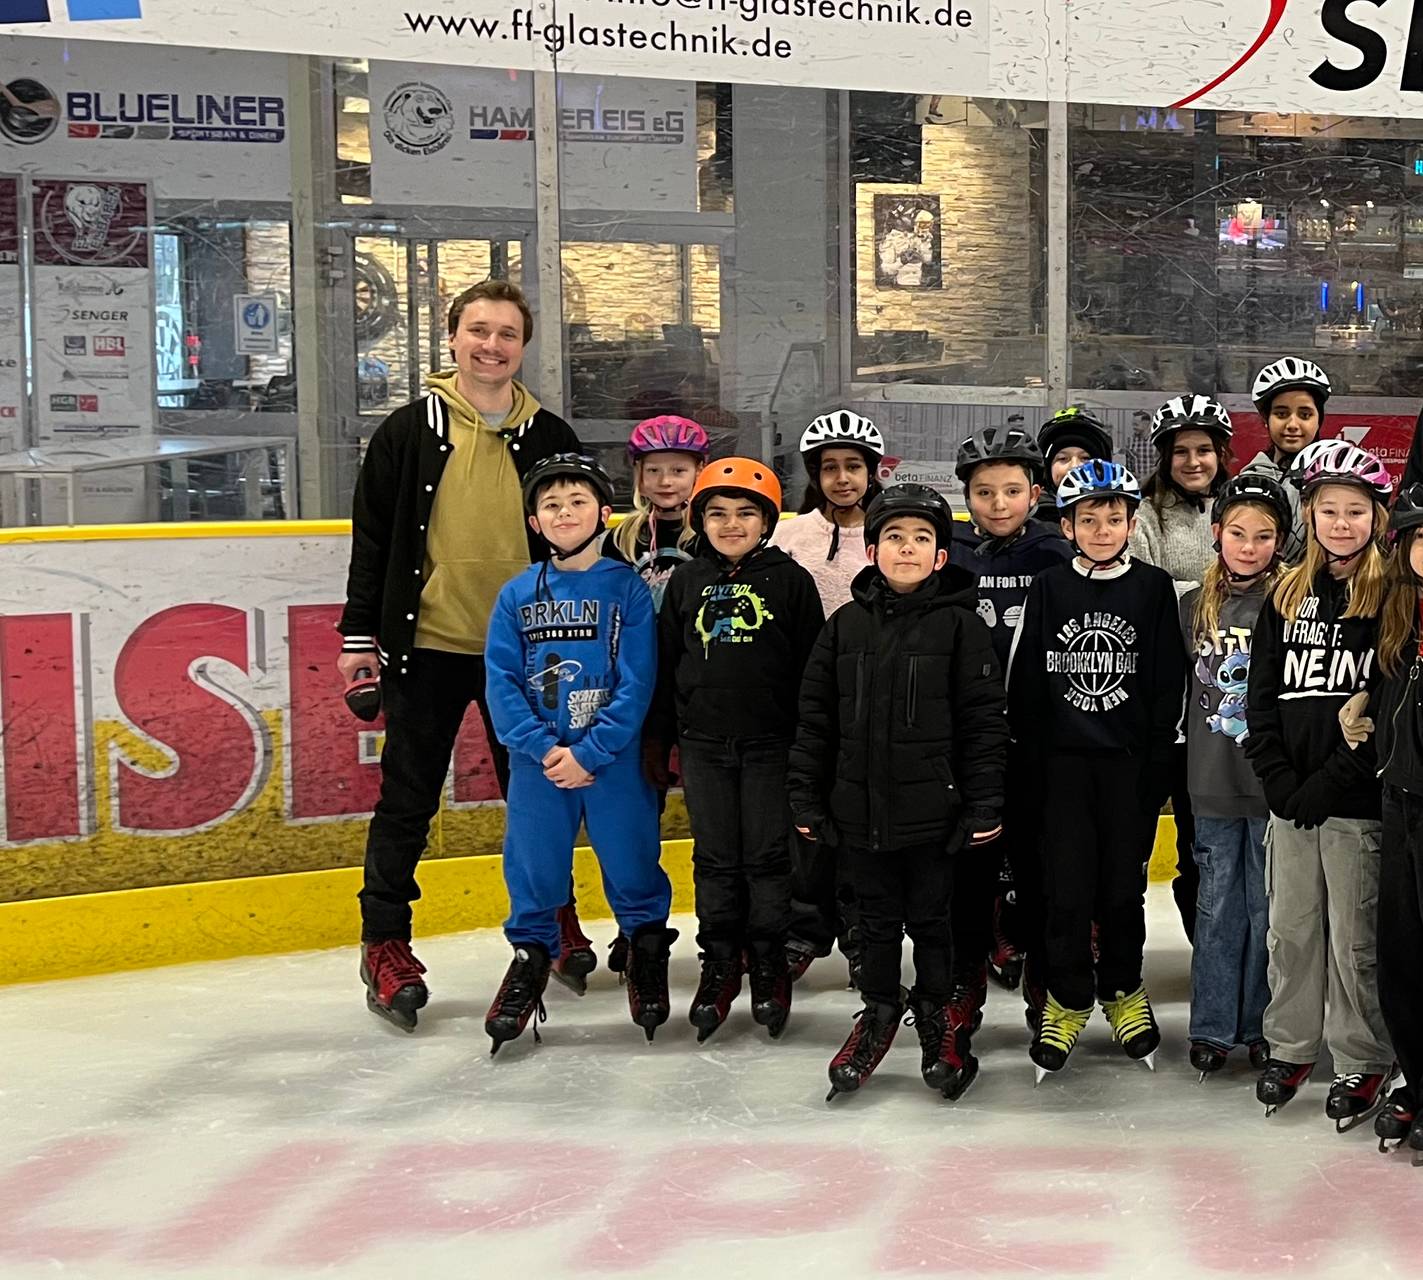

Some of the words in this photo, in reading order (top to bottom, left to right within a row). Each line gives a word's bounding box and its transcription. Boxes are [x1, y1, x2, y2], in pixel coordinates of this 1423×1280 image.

[403, 10, 793, 59] www.ff-glastechnik.de
[66, 91, 285, 127] BLUELINER
[469, 105, 594, 131] HAMER
[602, 109, 645, 132] EIS
[72, 310, 129, 321] SENGER
[978, 575, 995, 589] AN
[996, 576, 1017, 589] FOR
[1018, 575, 1035, 588] TO
[518, 599, 600, 633] BRKLN
[1056, 617, 1081, 645] LOS
[1083, 611, 1138, 646] ANGELES
[1283, 648, 1375, 691] NEIN!
[1063, 687, 1099, 712] YORK
[1102, 687, 1130, 712] NEW
